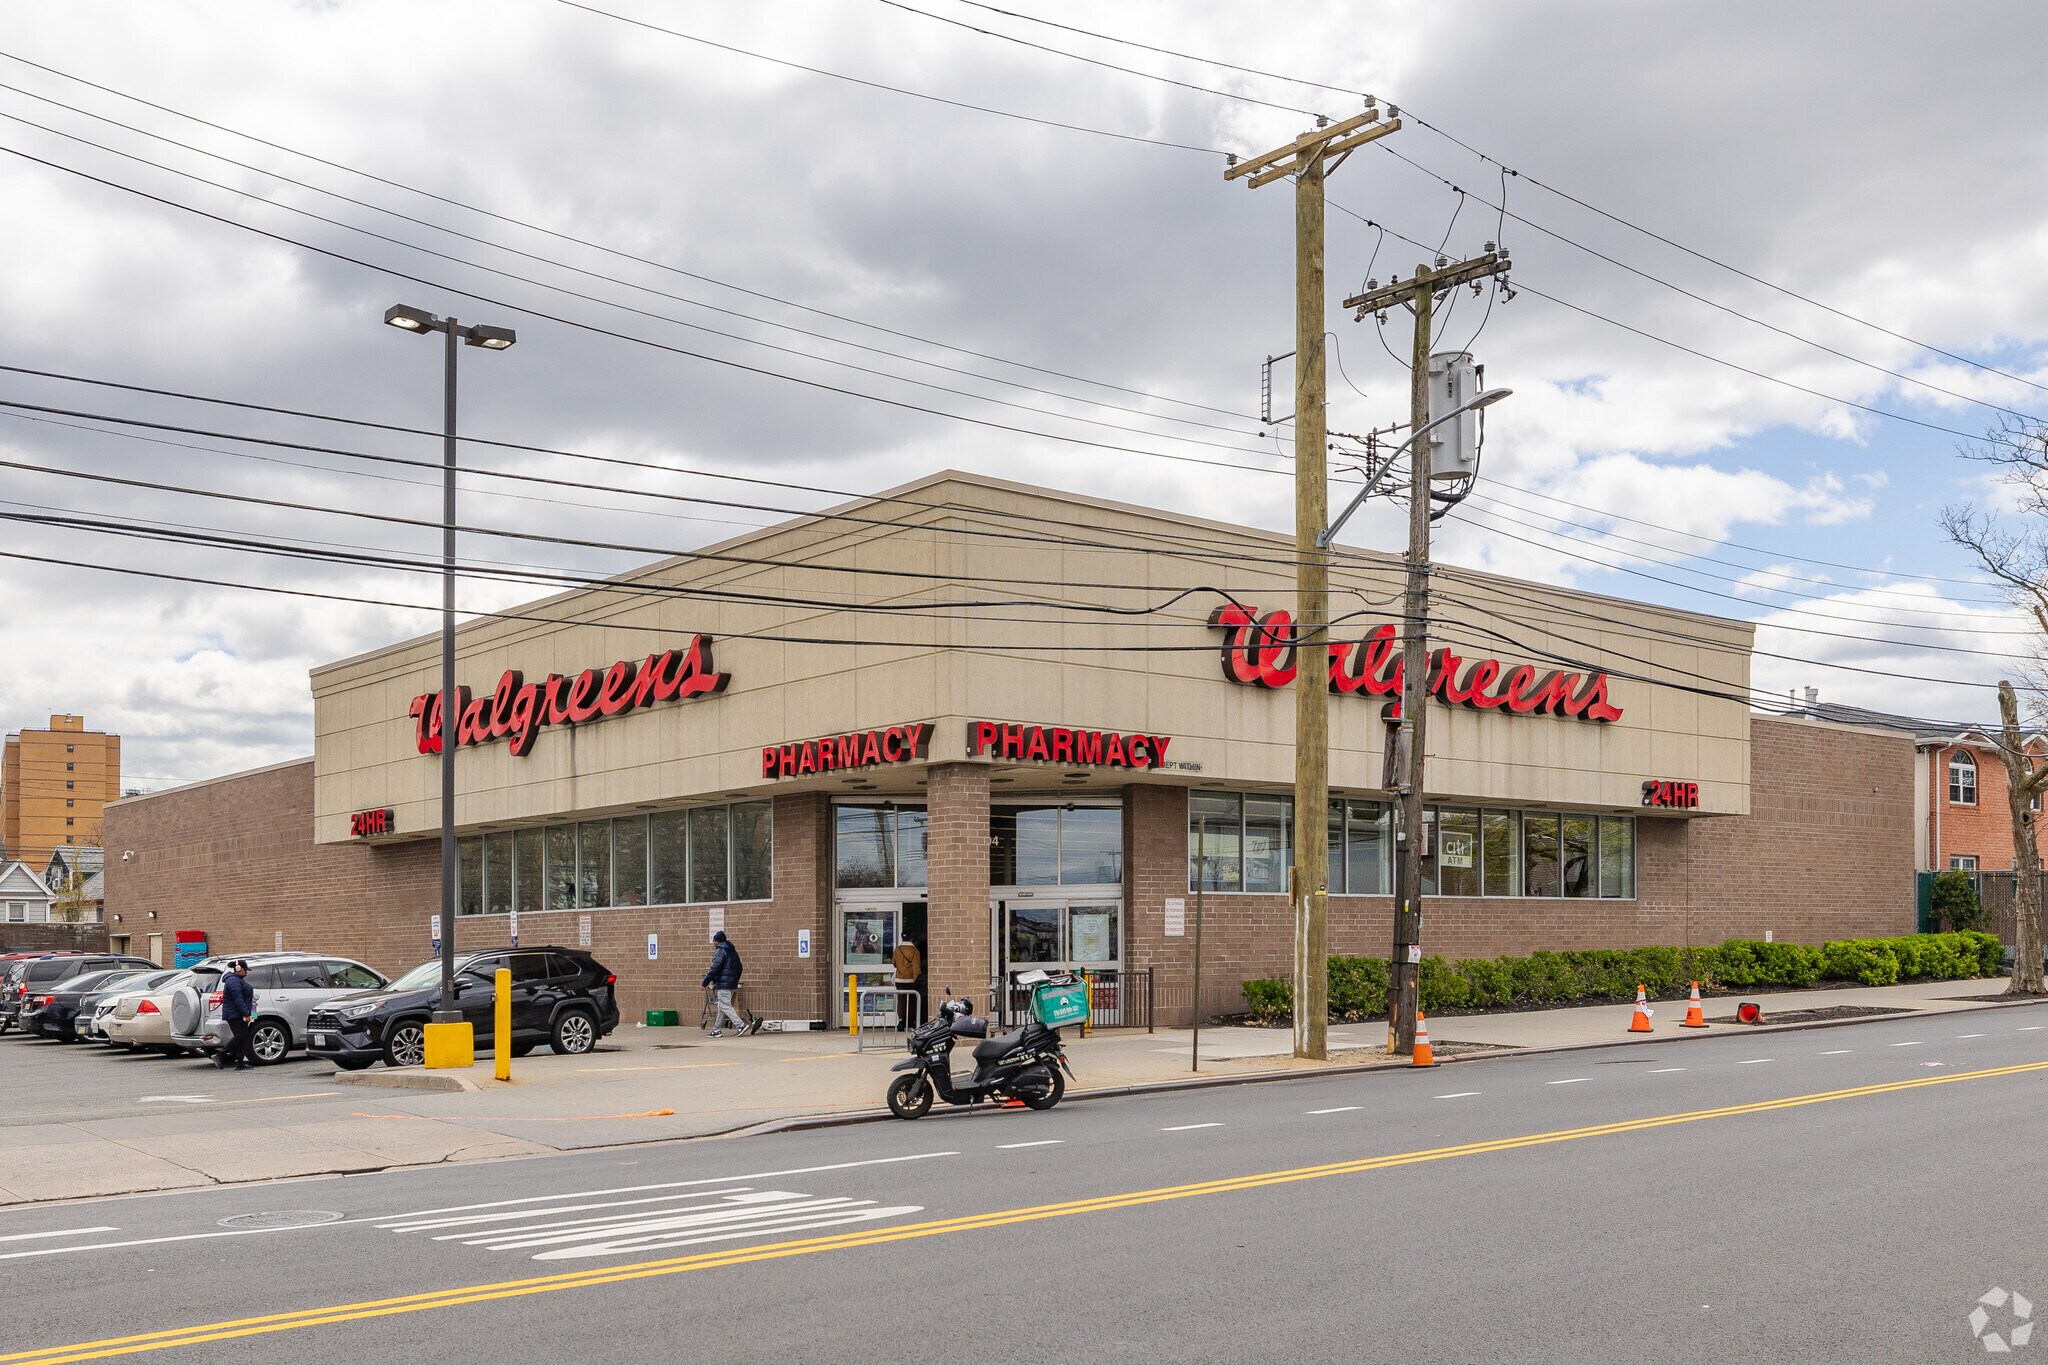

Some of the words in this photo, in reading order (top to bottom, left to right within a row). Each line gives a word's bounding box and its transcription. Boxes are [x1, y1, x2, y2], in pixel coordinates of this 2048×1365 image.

[409, 634, 731, 757] Walgreens
[763, 723, 932, 778] PHARMACY
[967, 721, 1171, 768] PHARMACY
[1163, 761, 1177, 769] EPT
[1647, 780, 1699, 807] 24HR
[351, 809, 389, 835] 24HR
[1447, 856, 1463, 865] ATM
